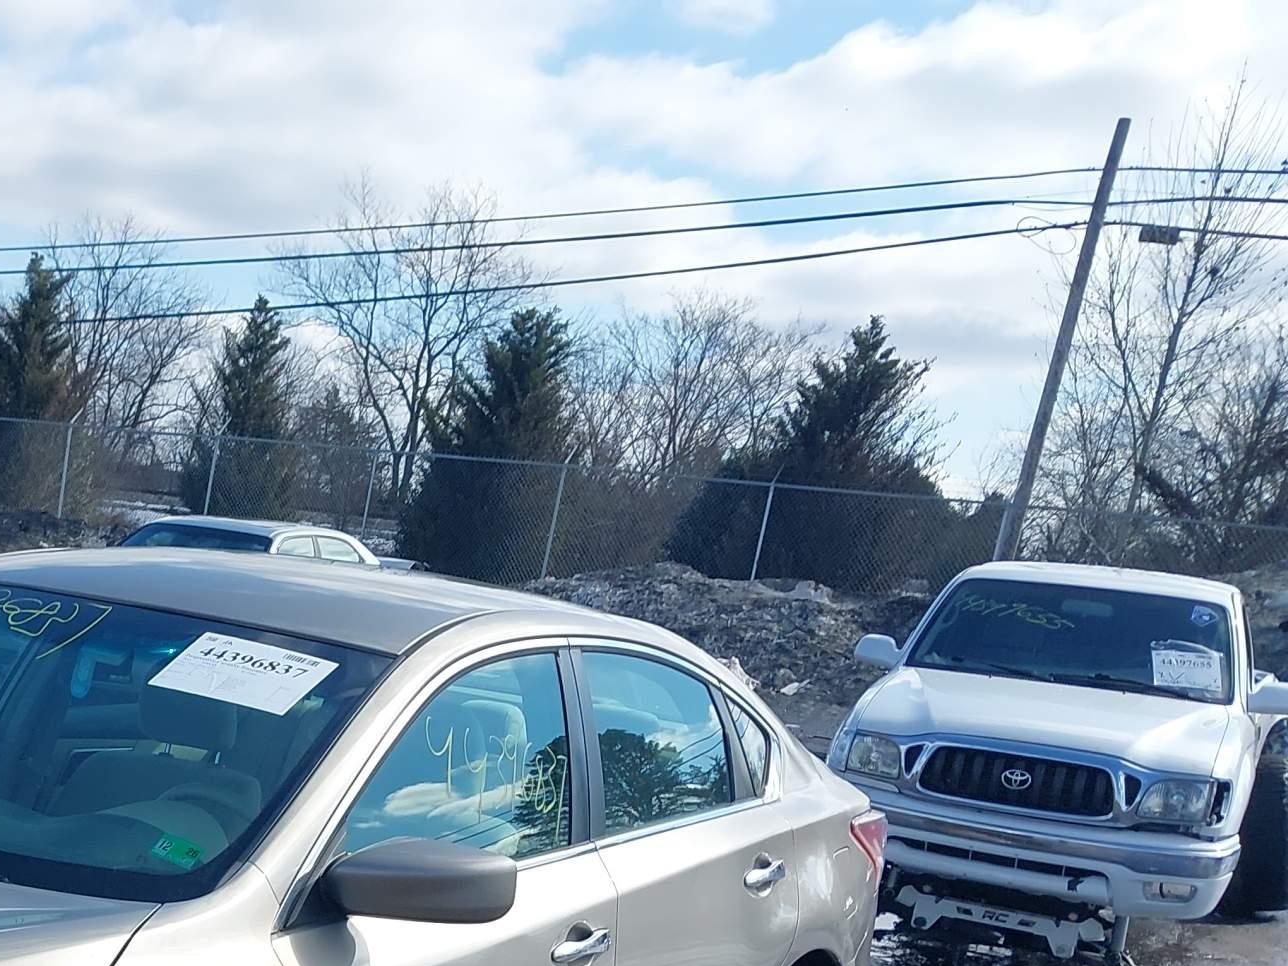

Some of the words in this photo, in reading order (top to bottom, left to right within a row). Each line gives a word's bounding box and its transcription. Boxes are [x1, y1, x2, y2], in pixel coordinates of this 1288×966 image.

[199, 647, 309, 679] 44396837
[425, 715, 568, 842] 44396837
[158, 839, 173, 852] 12
[981, 910, 1011, 924] RC
